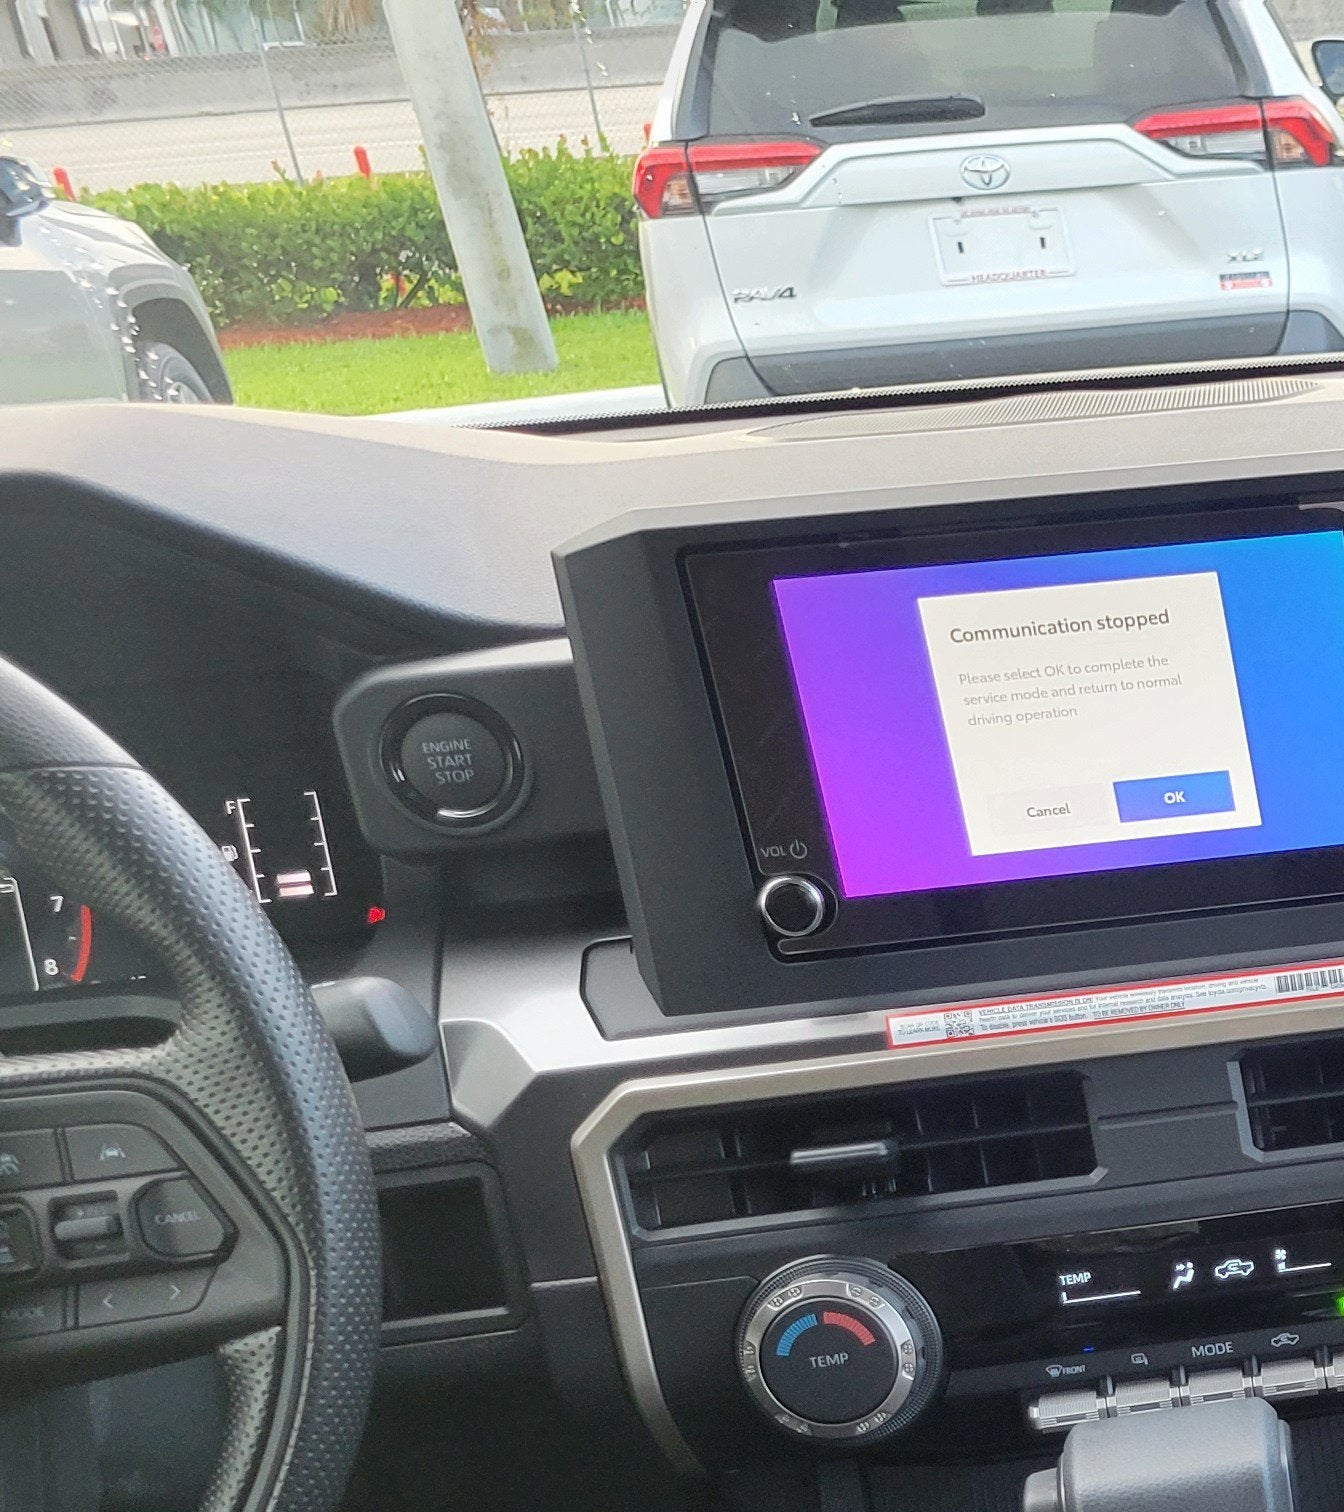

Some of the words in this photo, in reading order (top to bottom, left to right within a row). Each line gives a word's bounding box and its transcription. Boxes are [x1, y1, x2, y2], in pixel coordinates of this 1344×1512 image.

[732, 286, 796, 303] RAV4
[950, 618, 1092, 644] Communication
[1097, 609, 1170, 632] stopped
[959, 672, 1001, 685] Please
[1003, 668, 1042, 682] select
[1044, 664, 1065, 677] OK
[1068, 664, 1082, 675] to
[1084, 658, 1145, 674] complete
[1147, 655, 1169, 667] the
[963, 691, 1007, 706] service
[1011, 687, 1048, 702] mode
[1051, 684, 1076, 697] and
[1079, 681, 1117, 695] return
[1121, 679, 1134, 690] to
[1136, 673, 1183, 689] normal
[968, 711, 1013, 727] driving
[1016, 705, 1077, 723] operation
[422, 739, 471, 754] ENGINE
[427, 753, 472, 770] START
[435, 769, 474, 785] STOP
[1164, 791, 1185, 804] OK
[225, 800, 236, 815] F
[1026, 803, 1071, 818] Cancel
[760, 845, 787, 858] VOL
[50, 895, 64, 913] 7
[44, 959, 59, 976] 8
[978, 1008, 1006, 1016] VEHICLE
[1026, 1000, 1073, 1010] TRANSMISSION
[1110, 1006, 1138, 1015] REMOVED
[155, 1210, 199, 1224] CANCEL
[1059, 1271, 1092, 1286] TEMP
[1191, 1341, 1234, 1358] MODE
[809, 1352, 849, 1368] TEMP
[1062, 1365, 1086, 1375] FRONT
